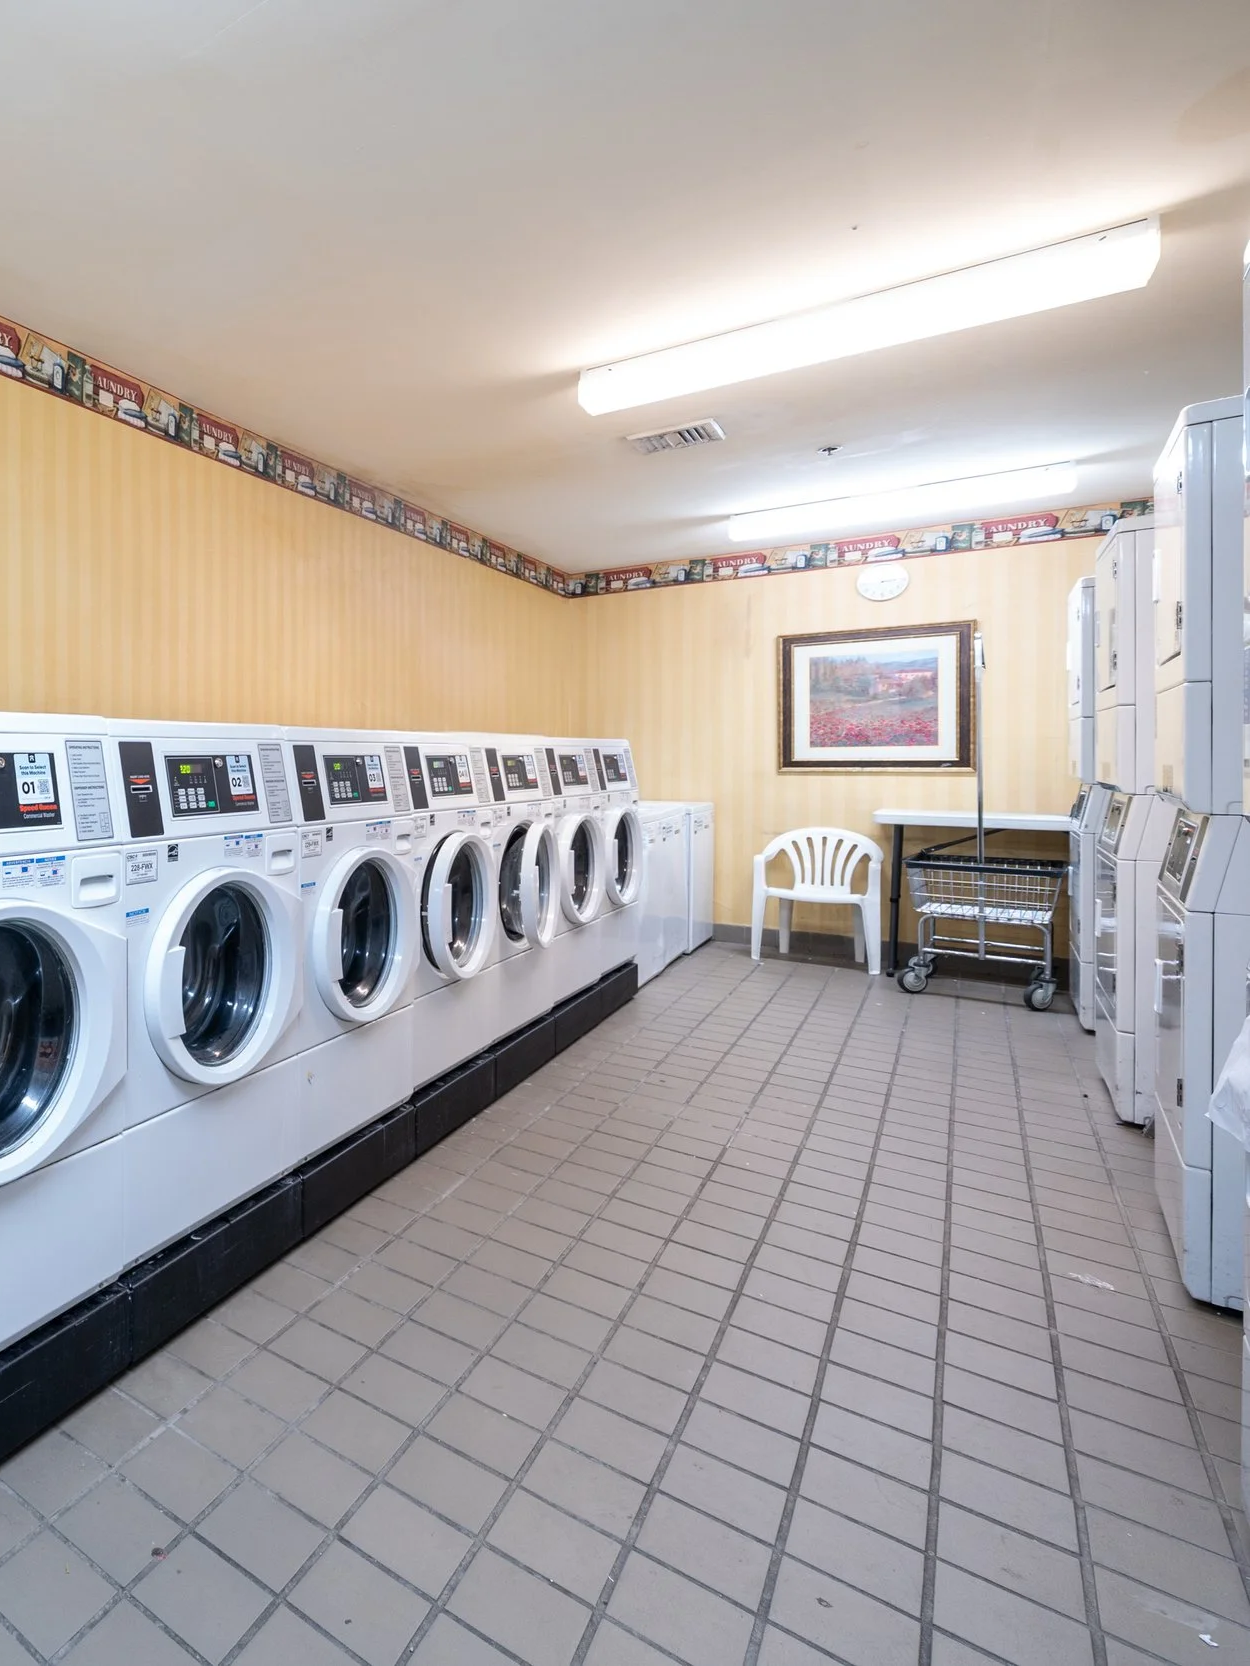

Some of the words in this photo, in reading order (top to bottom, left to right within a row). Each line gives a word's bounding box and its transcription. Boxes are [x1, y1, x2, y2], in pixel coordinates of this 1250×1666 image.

[231, 777, 242, 787] 02
[368, 773, 376, 782] 03
[22, 781, 36, 794] 01
[130, 862, 153, 872] 228-FWX
